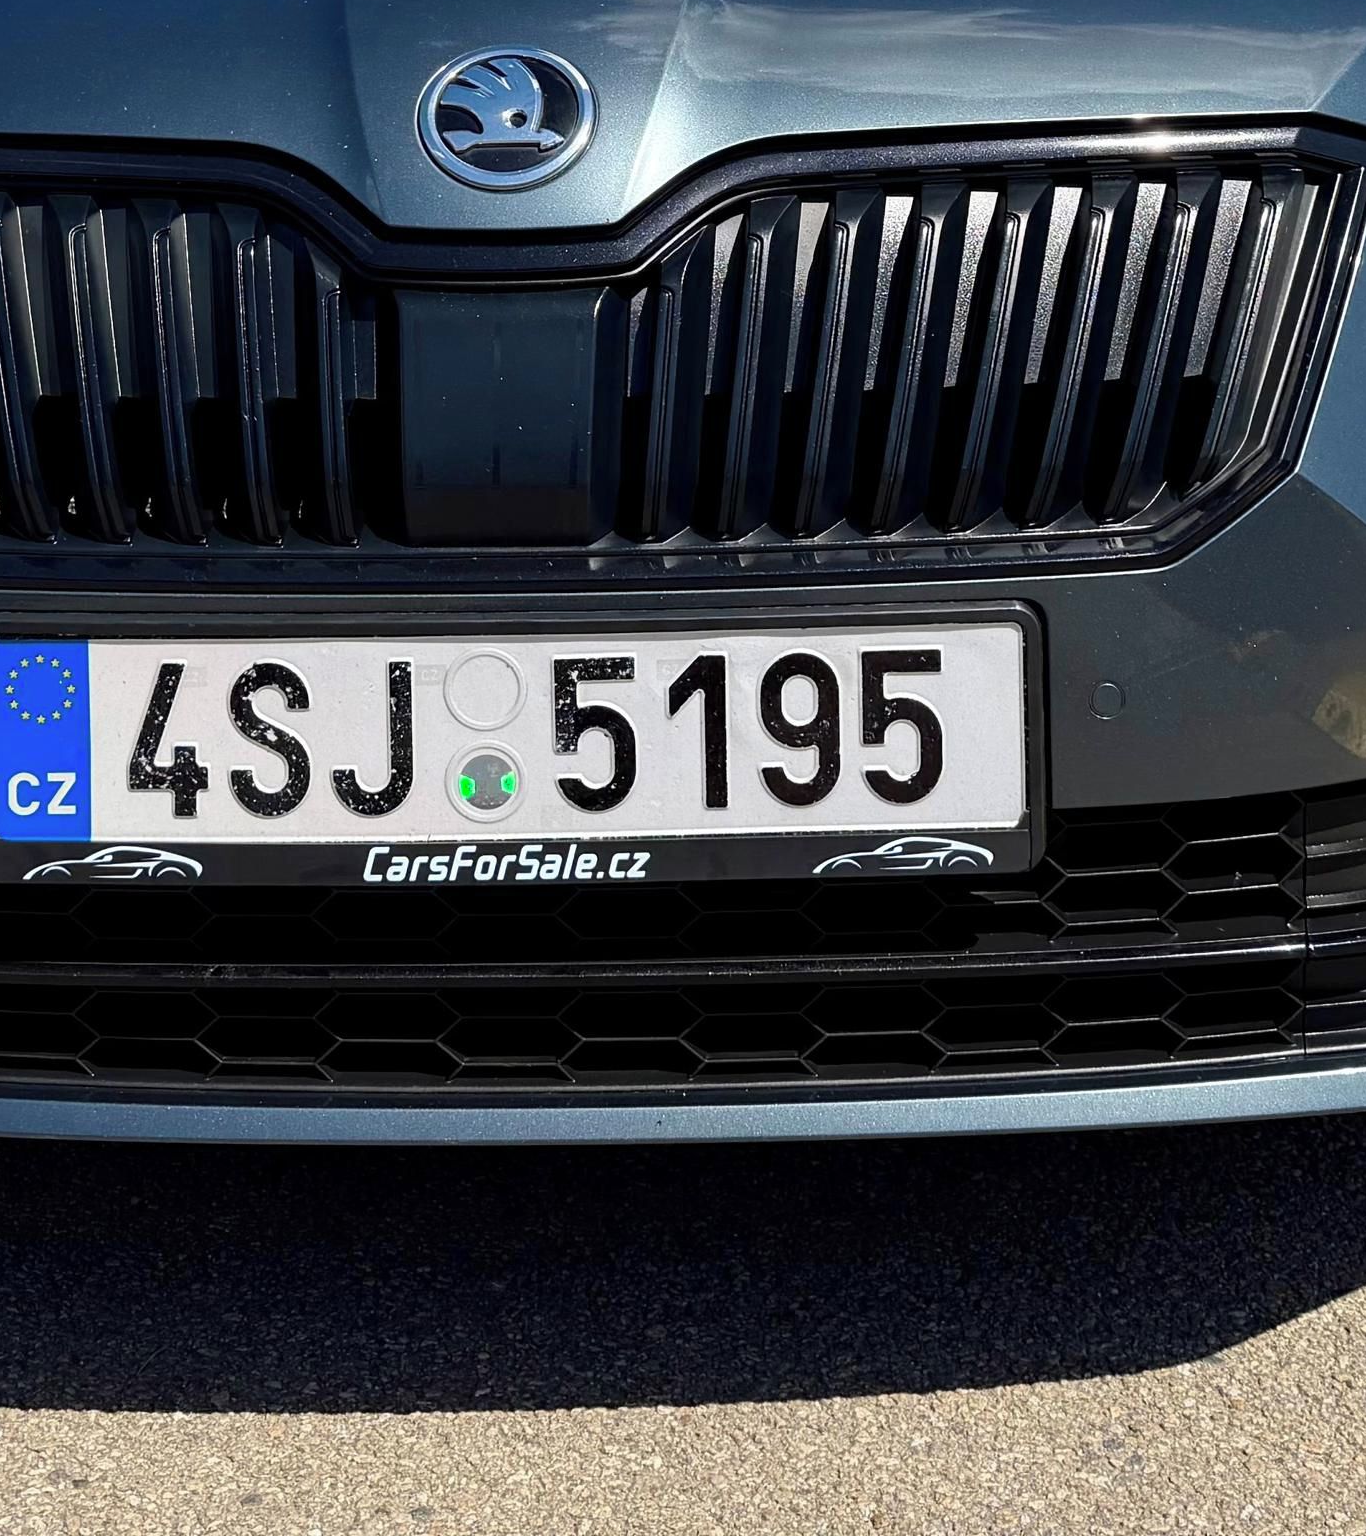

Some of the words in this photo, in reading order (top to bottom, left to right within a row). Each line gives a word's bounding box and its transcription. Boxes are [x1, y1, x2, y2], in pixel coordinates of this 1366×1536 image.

[128, 658, 413, 818] 4SJ
[552, 645, 944, 813] 5195
[7, 771, 78, 816] CZ
[363, 843, 651, 882] CarsForSale.cz
